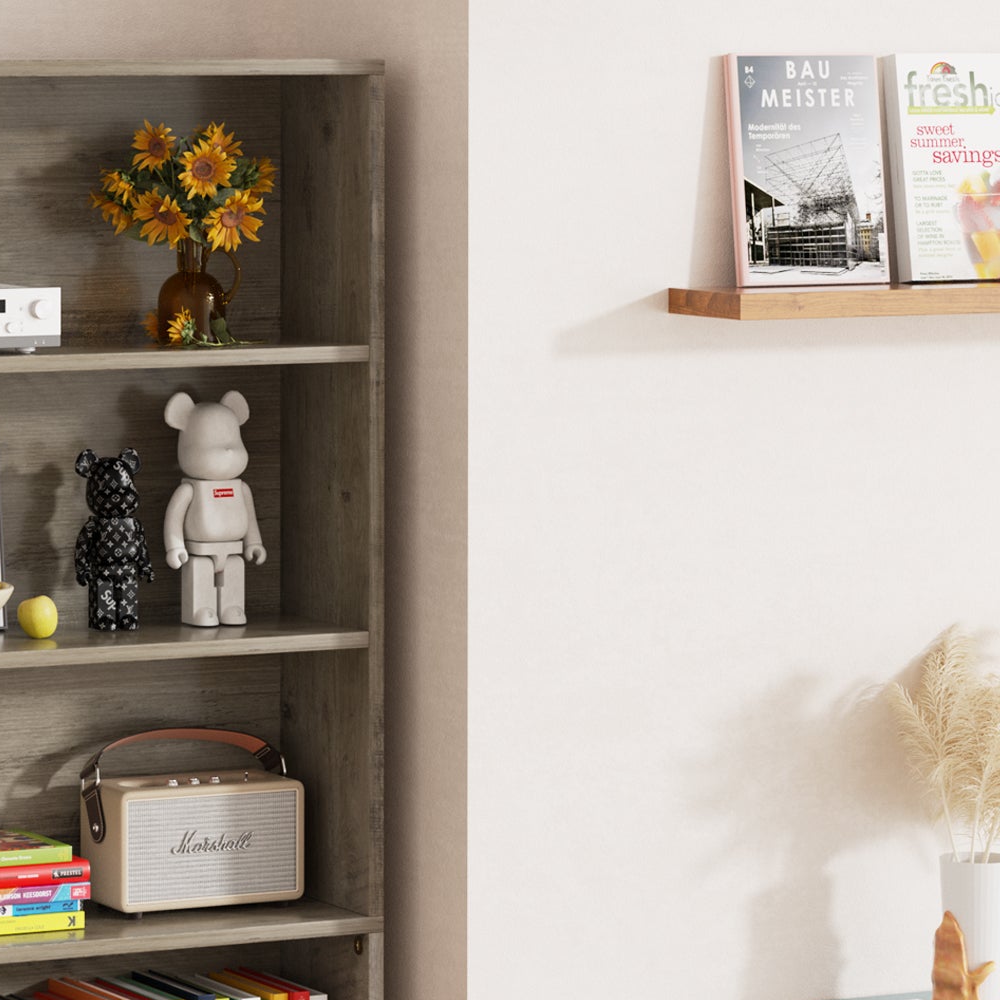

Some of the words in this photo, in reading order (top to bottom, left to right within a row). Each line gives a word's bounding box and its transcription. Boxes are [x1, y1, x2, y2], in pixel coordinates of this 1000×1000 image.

[786, 60, 830, 80] BAU
[761, 88, 855, 108] MEISTER
[916, 123, 955, 136] sweet
[910, 138, 965, 148] summer
[932, 146, 1000, 168] savings
[170, 830, 255, 855] Marshall
